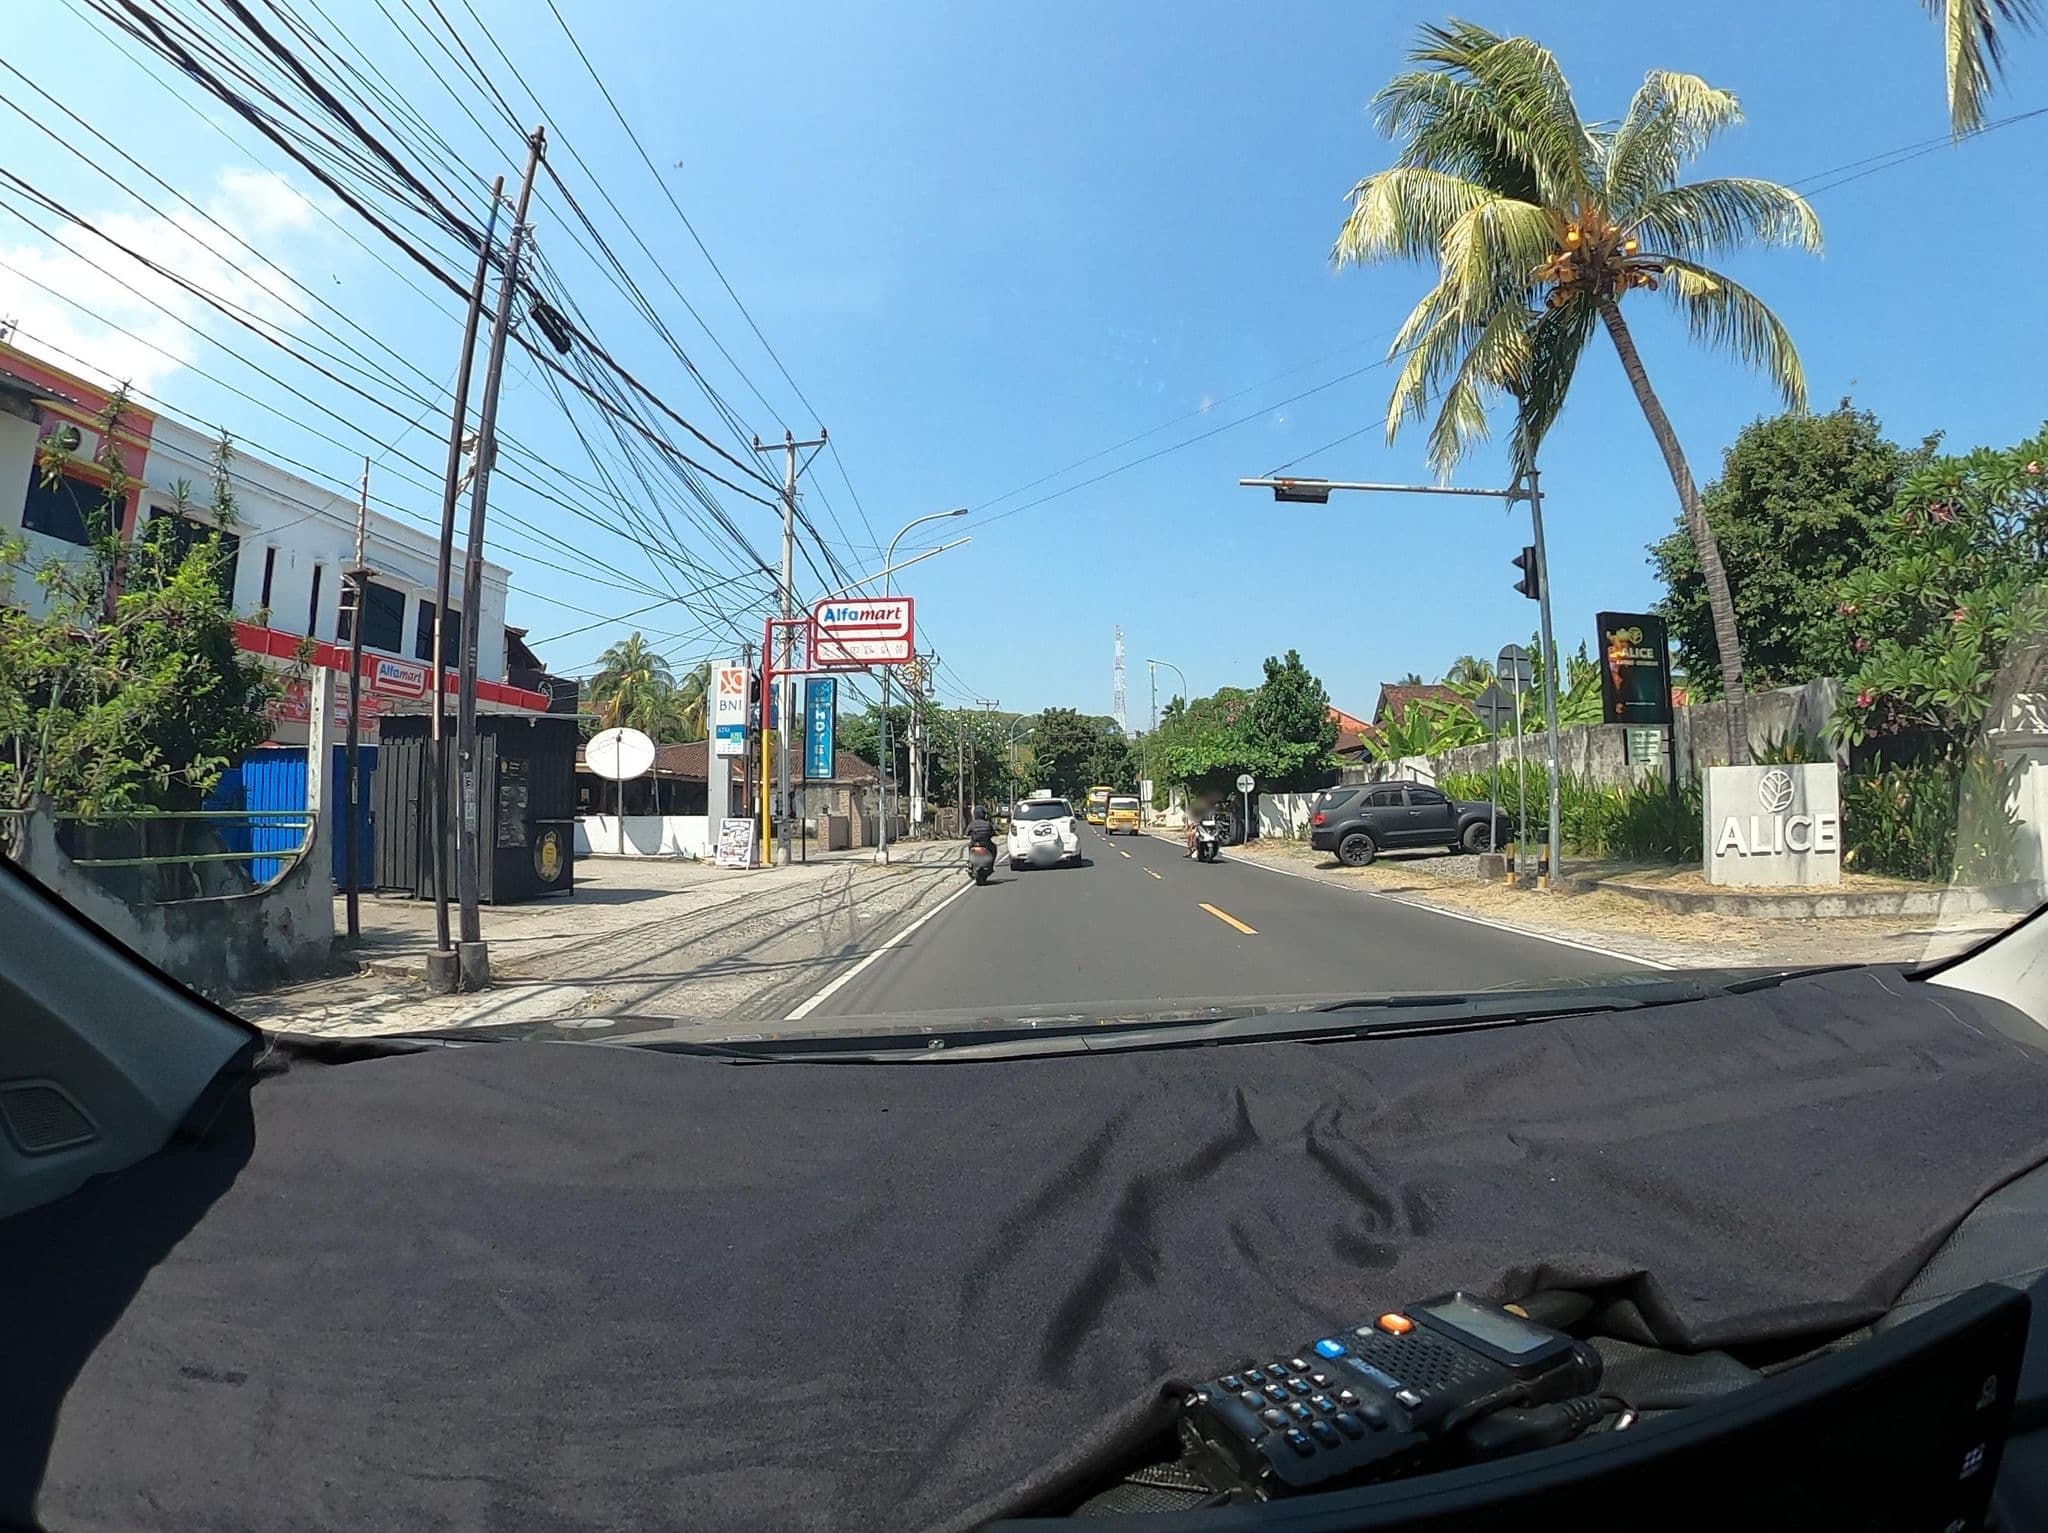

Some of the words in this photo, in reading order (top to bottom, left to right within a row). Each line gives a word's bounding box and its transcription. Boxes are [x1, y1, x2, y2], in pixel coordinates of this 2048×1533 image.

[824, 607, 902, 622] Alfamart
[1620, 647, 1655, 659] ALICE
[379, 662, 422, 684] Alfamart
[719, 699, 742, 711] BNI
[1715, 814, 1836, 857] ALICE
